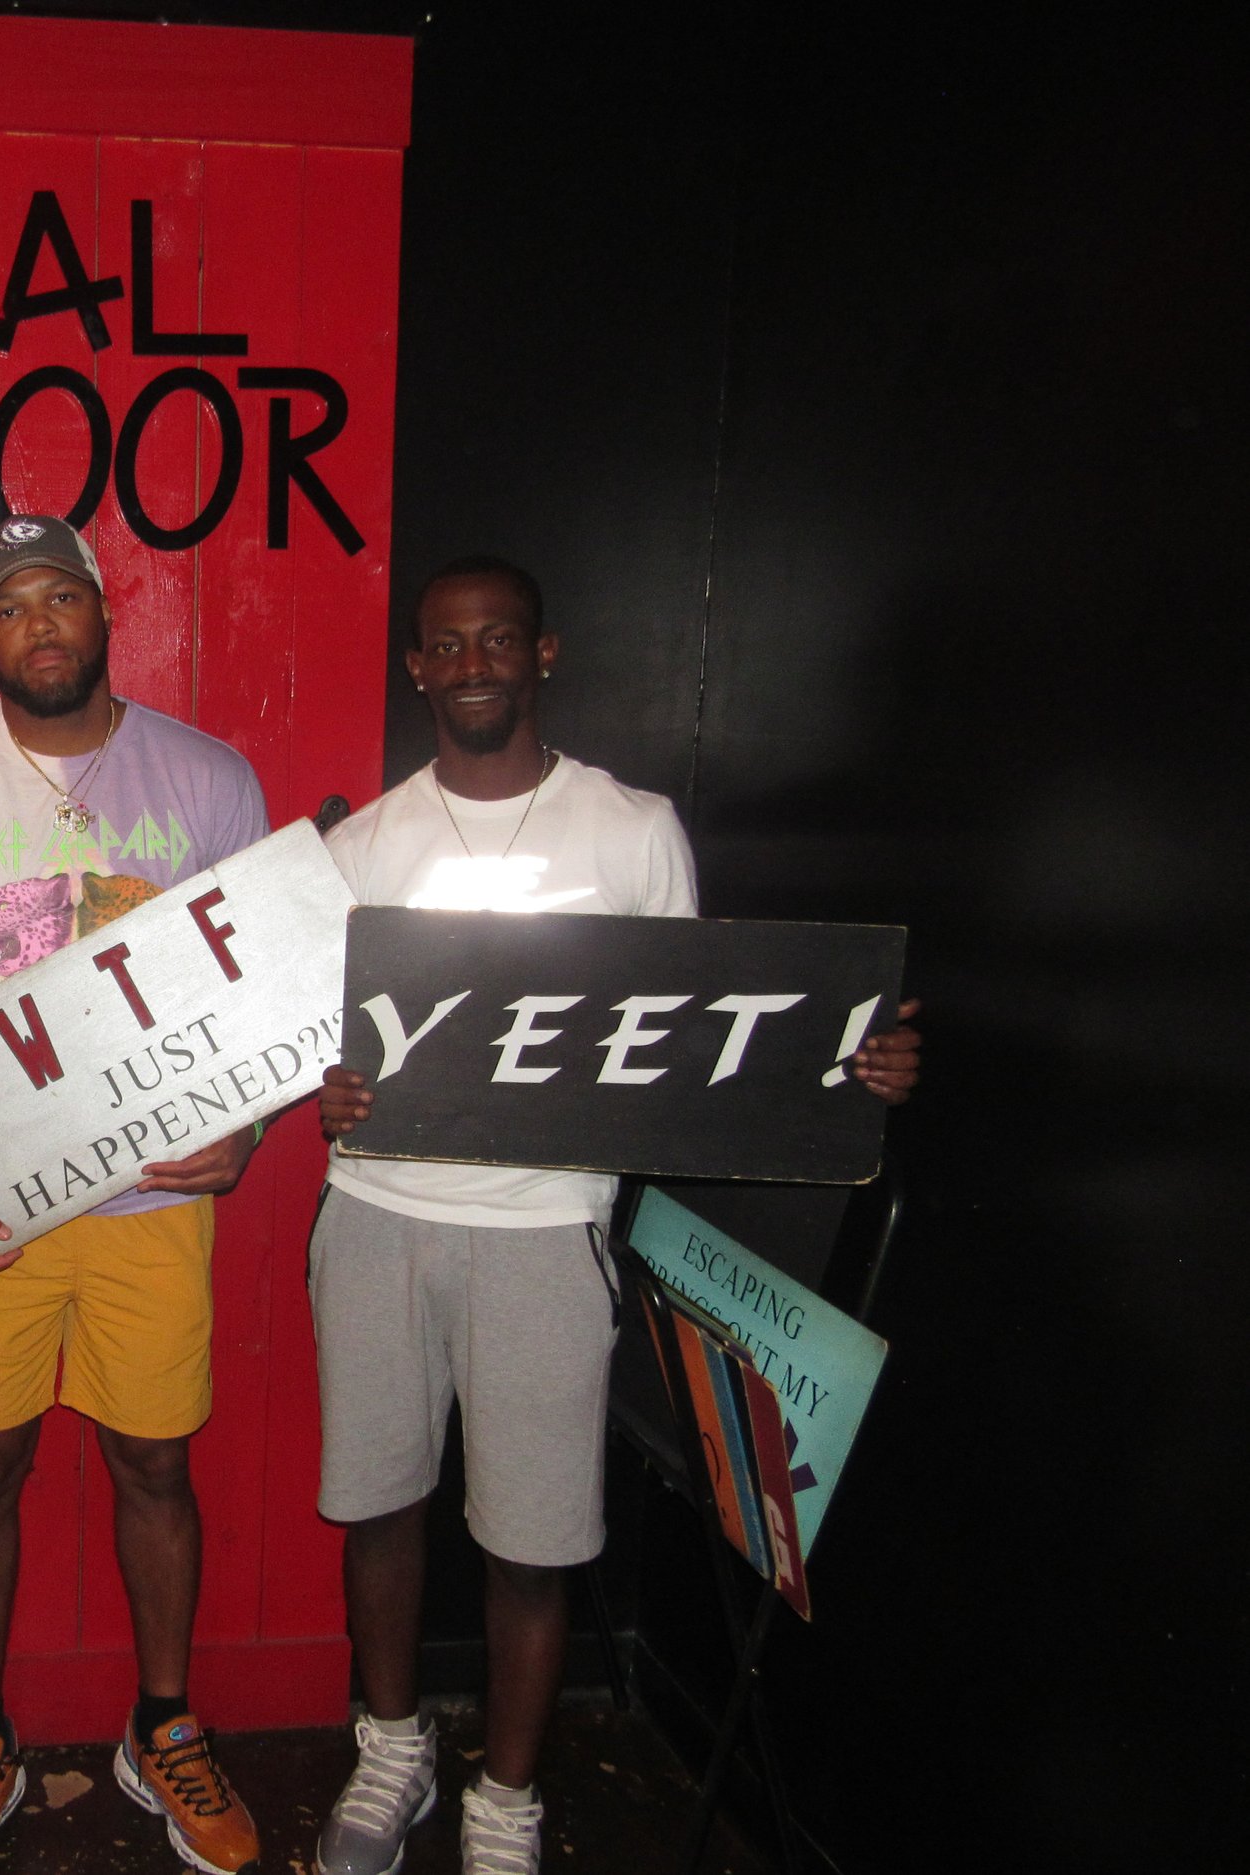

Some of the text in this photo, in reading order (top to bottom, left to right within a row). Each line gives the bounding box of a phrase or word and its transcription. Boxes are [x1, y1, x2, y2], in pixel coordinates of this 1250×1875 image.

[100, 1013, 223, 1109] JUST
[682, 1233, 805, 1340] ESCAPING
[779, 1363, 829, 1418] MY
